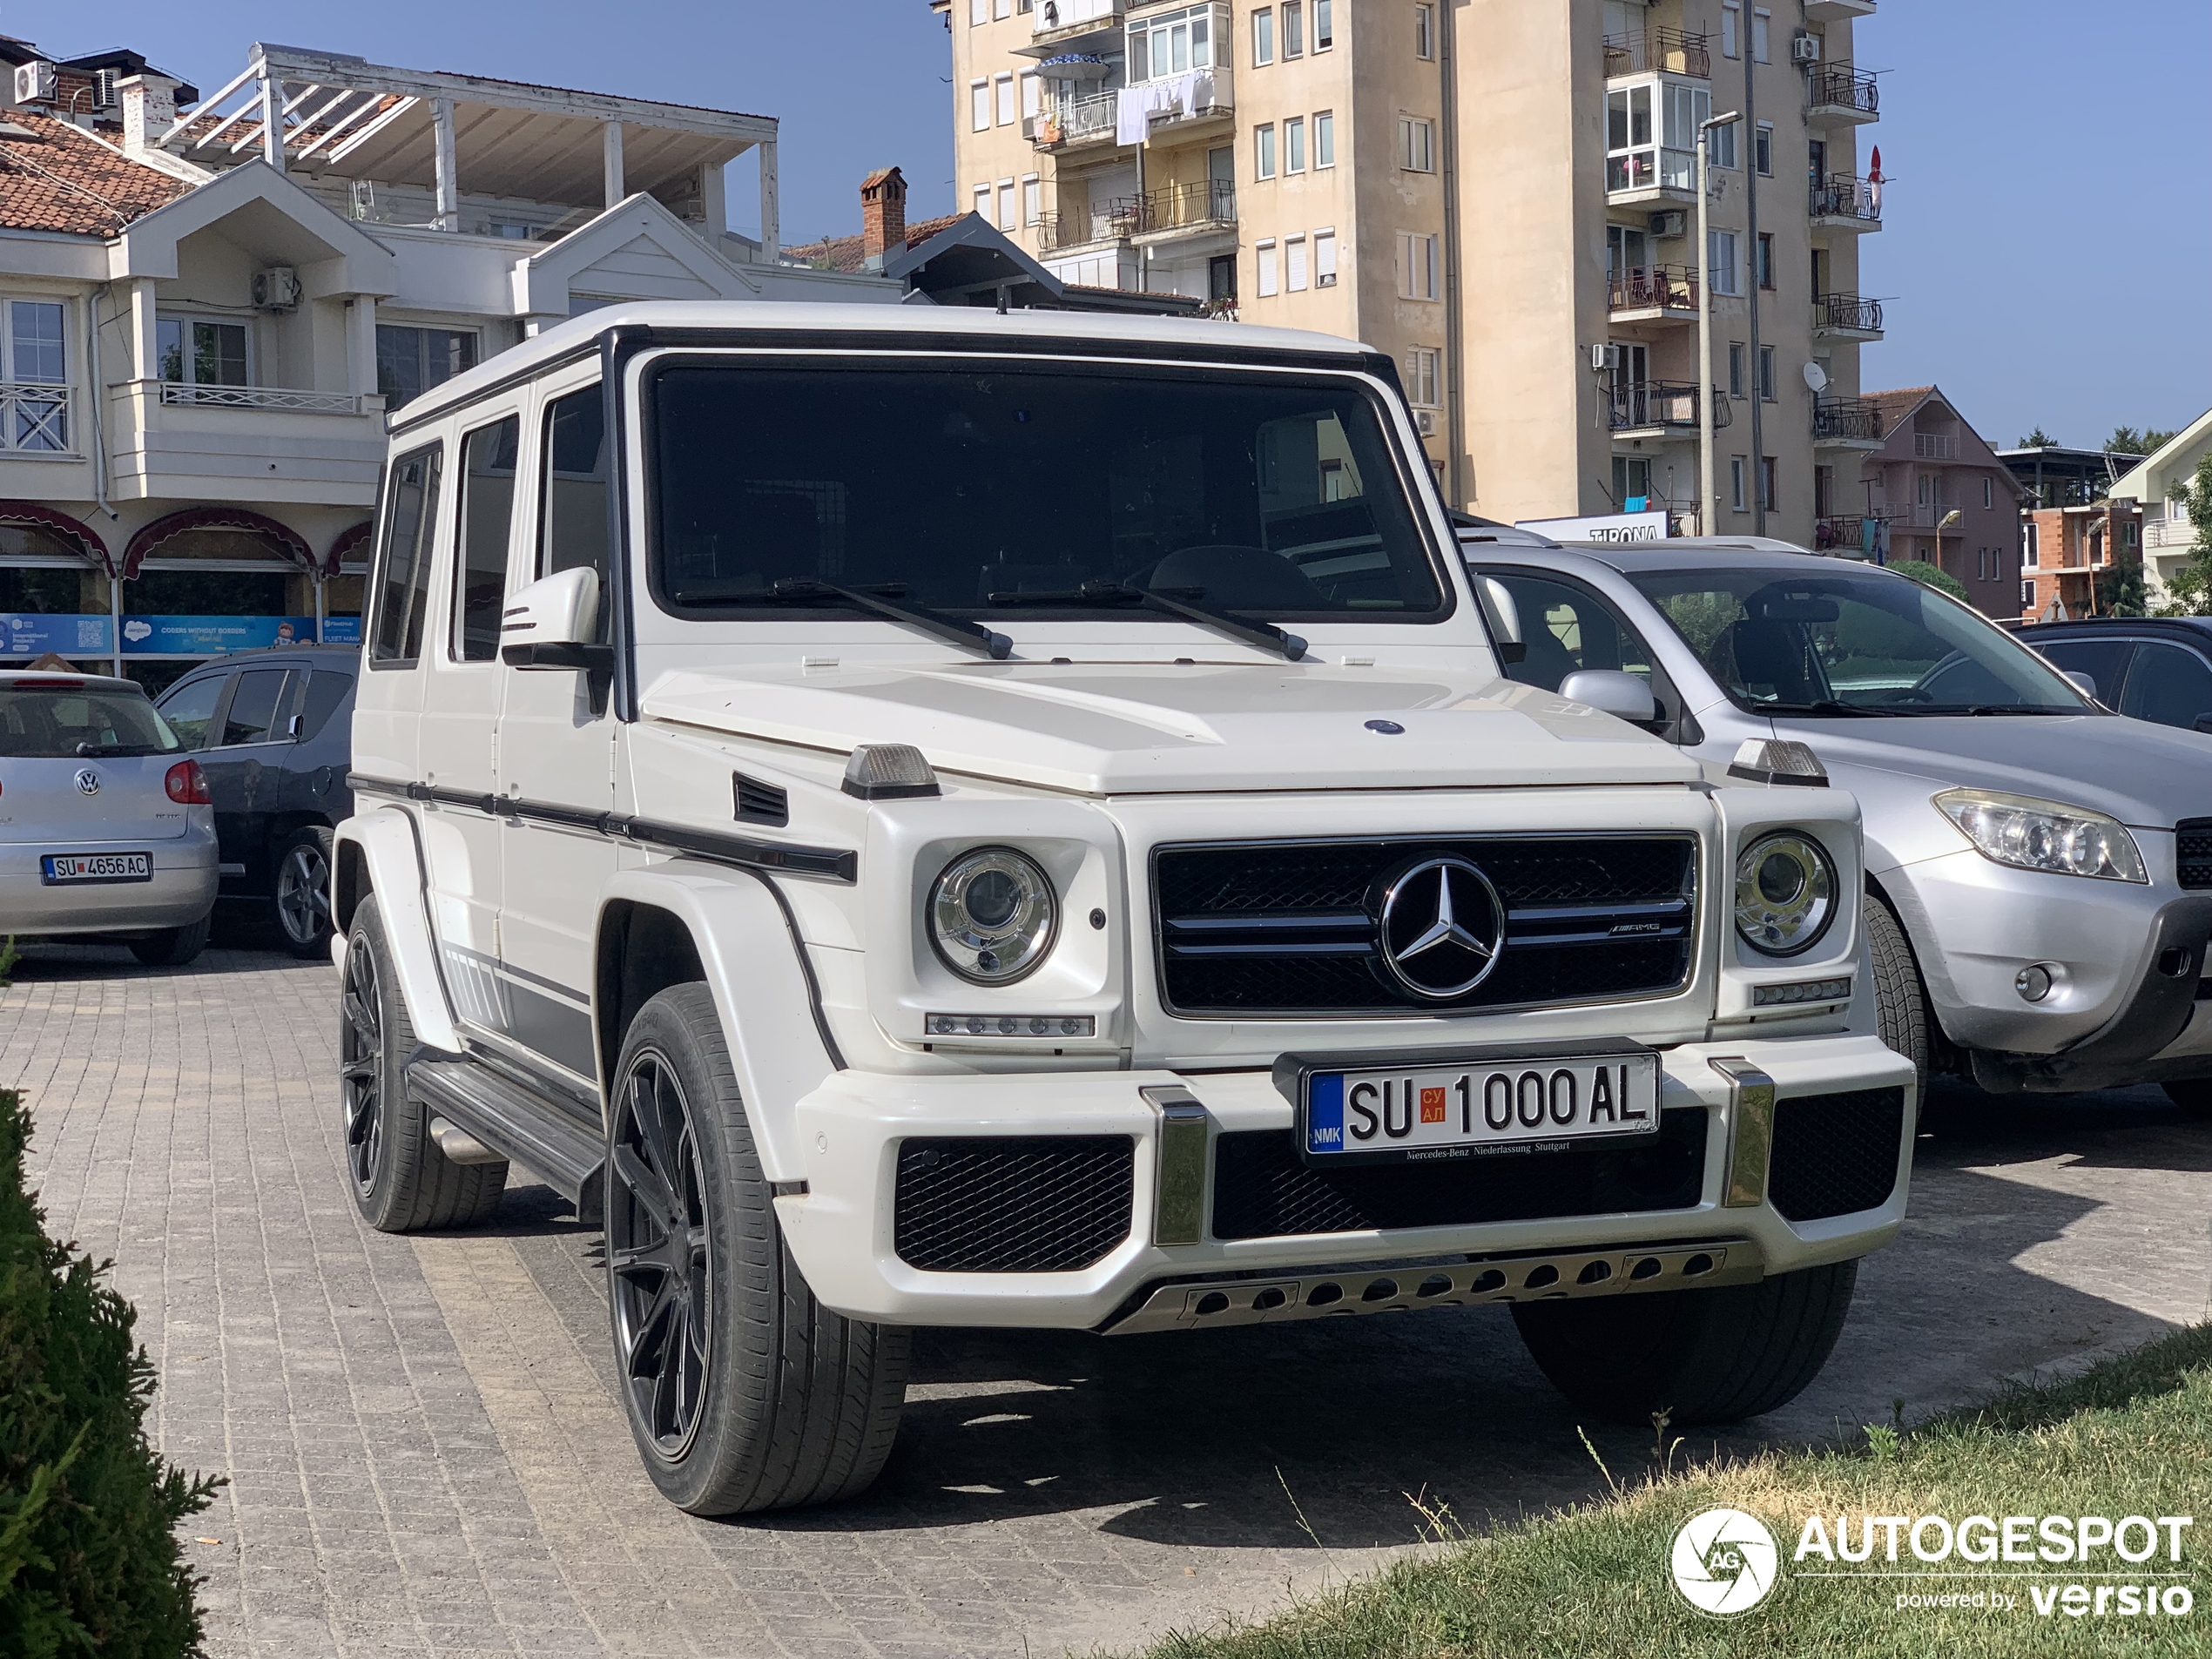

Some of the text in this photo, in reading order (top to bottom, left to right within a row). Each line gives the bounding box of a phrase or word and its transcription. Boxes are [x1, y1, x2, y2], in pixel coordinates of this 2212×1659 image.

[77, 771, 100, 795] VW
[57, 857, 145, 876] SU 4656 AC
[1628, 923, 1660, 932] AMG
[1348, 1063, 1648, 1140] SU 1000 AL
[1422, 1089, 1443, 1104] СУ
[1422, 1108, 1444, 1122] АЛ
[1313, 1127, 1341, 1143] NMK
[1406, 1141, 1570, 1160] Mercedes-Benz Niederlassung Stuttgart
